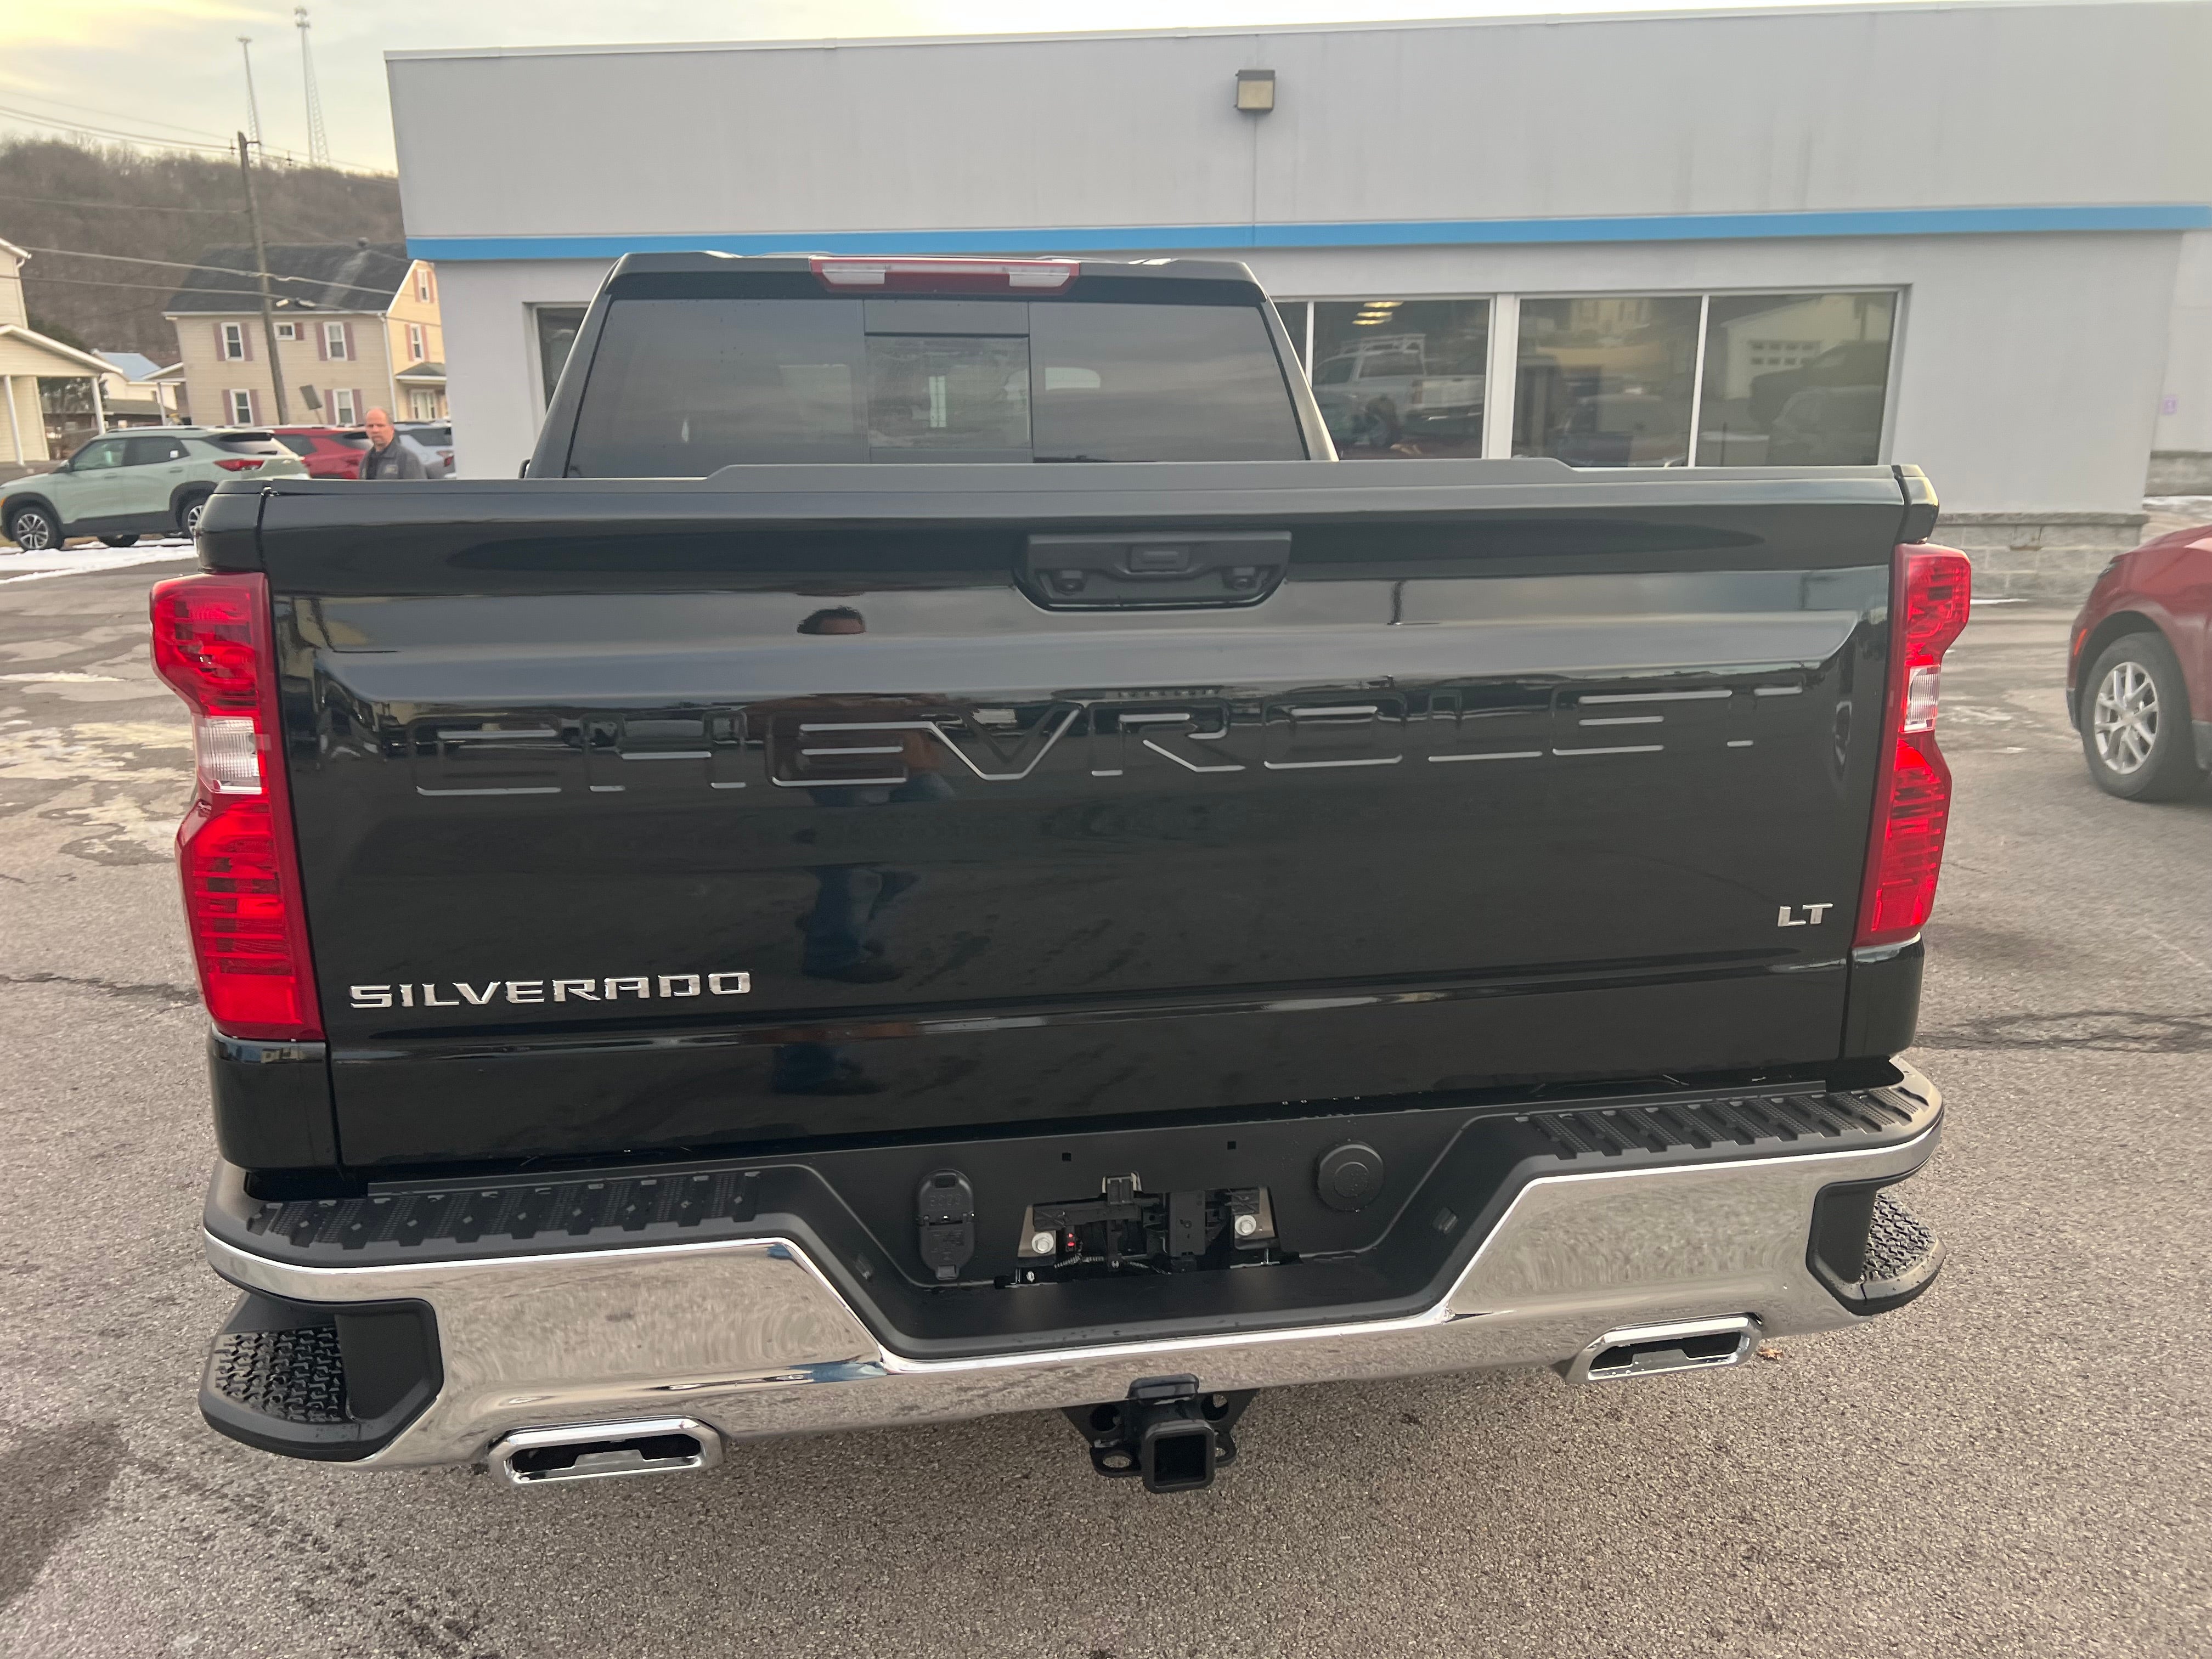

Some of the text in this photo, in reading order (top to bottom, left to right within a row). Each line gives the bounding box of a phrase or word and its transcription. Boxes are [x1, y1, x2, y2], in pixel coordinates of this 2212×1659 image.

[408, 675, 1804, 796] CHEVROLET
[1778, 903, 1833, 927] LT
[350, 971, 751, 1008] SILVERADO
